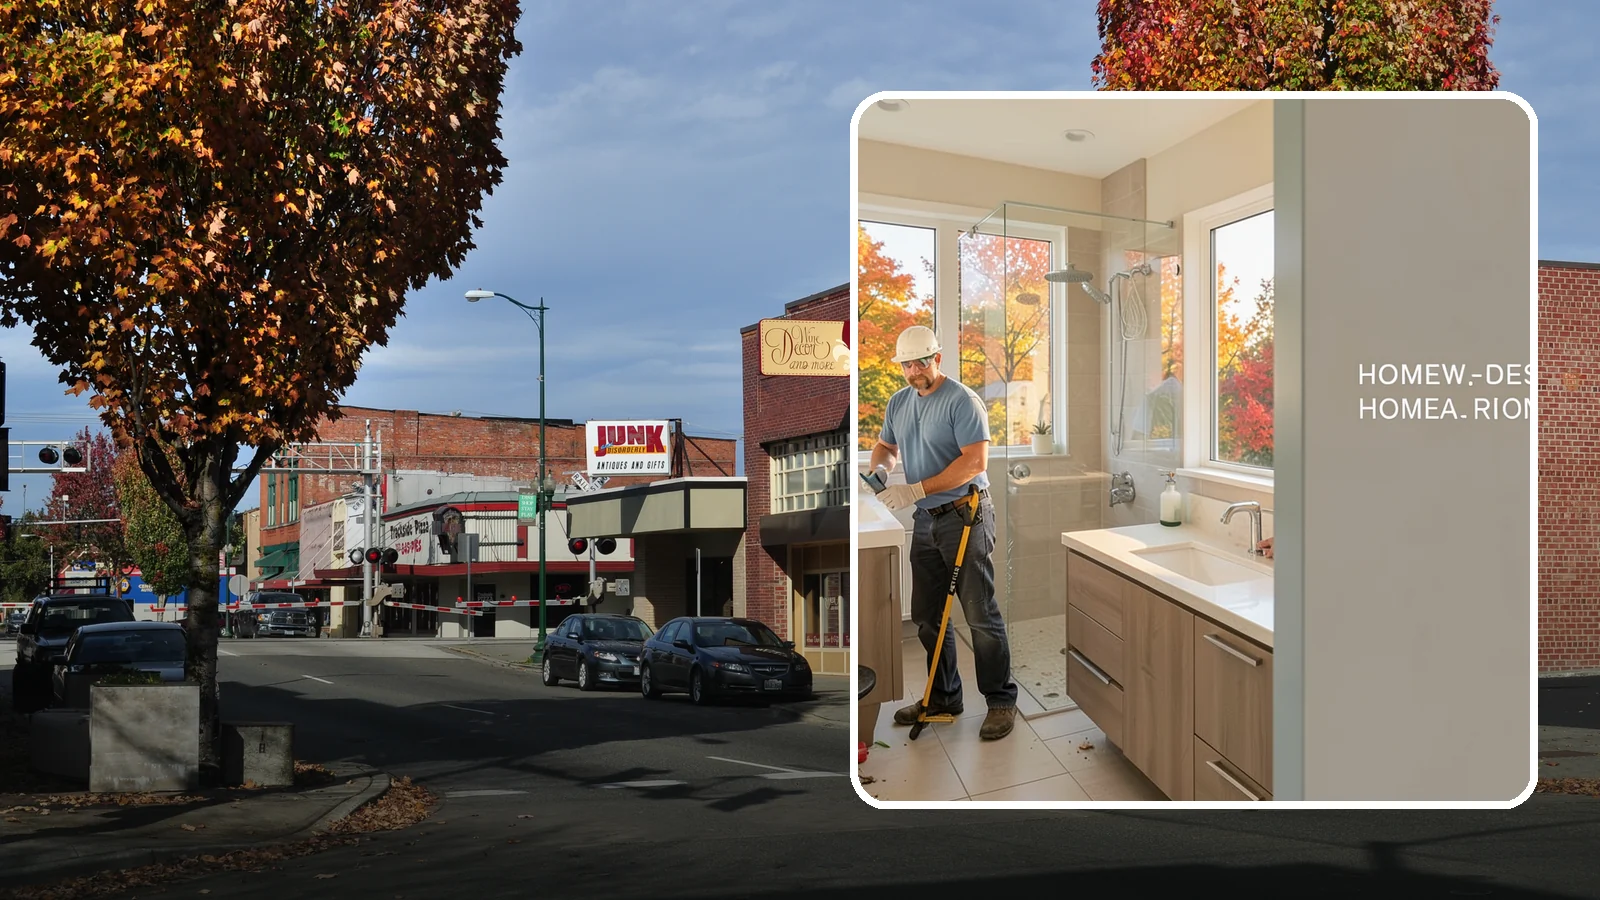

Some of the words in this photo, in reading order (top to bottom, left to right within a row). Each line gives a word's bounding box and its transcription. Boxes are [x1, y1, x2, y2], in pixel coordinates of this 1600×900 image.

[1474, 397, 1530, 420] RIO
[596, 425, 665, 457] JUNK
[607, 446, 646, 454] DISORDERLY
[597, 461, 628, 470] ANTIQUES
[631, 461, 644, 470] AND
[647, 460, 666, 469] GIFTS
[390, 521, 413, 540] Trackside
[414, 519, 429, 535] Pizza
